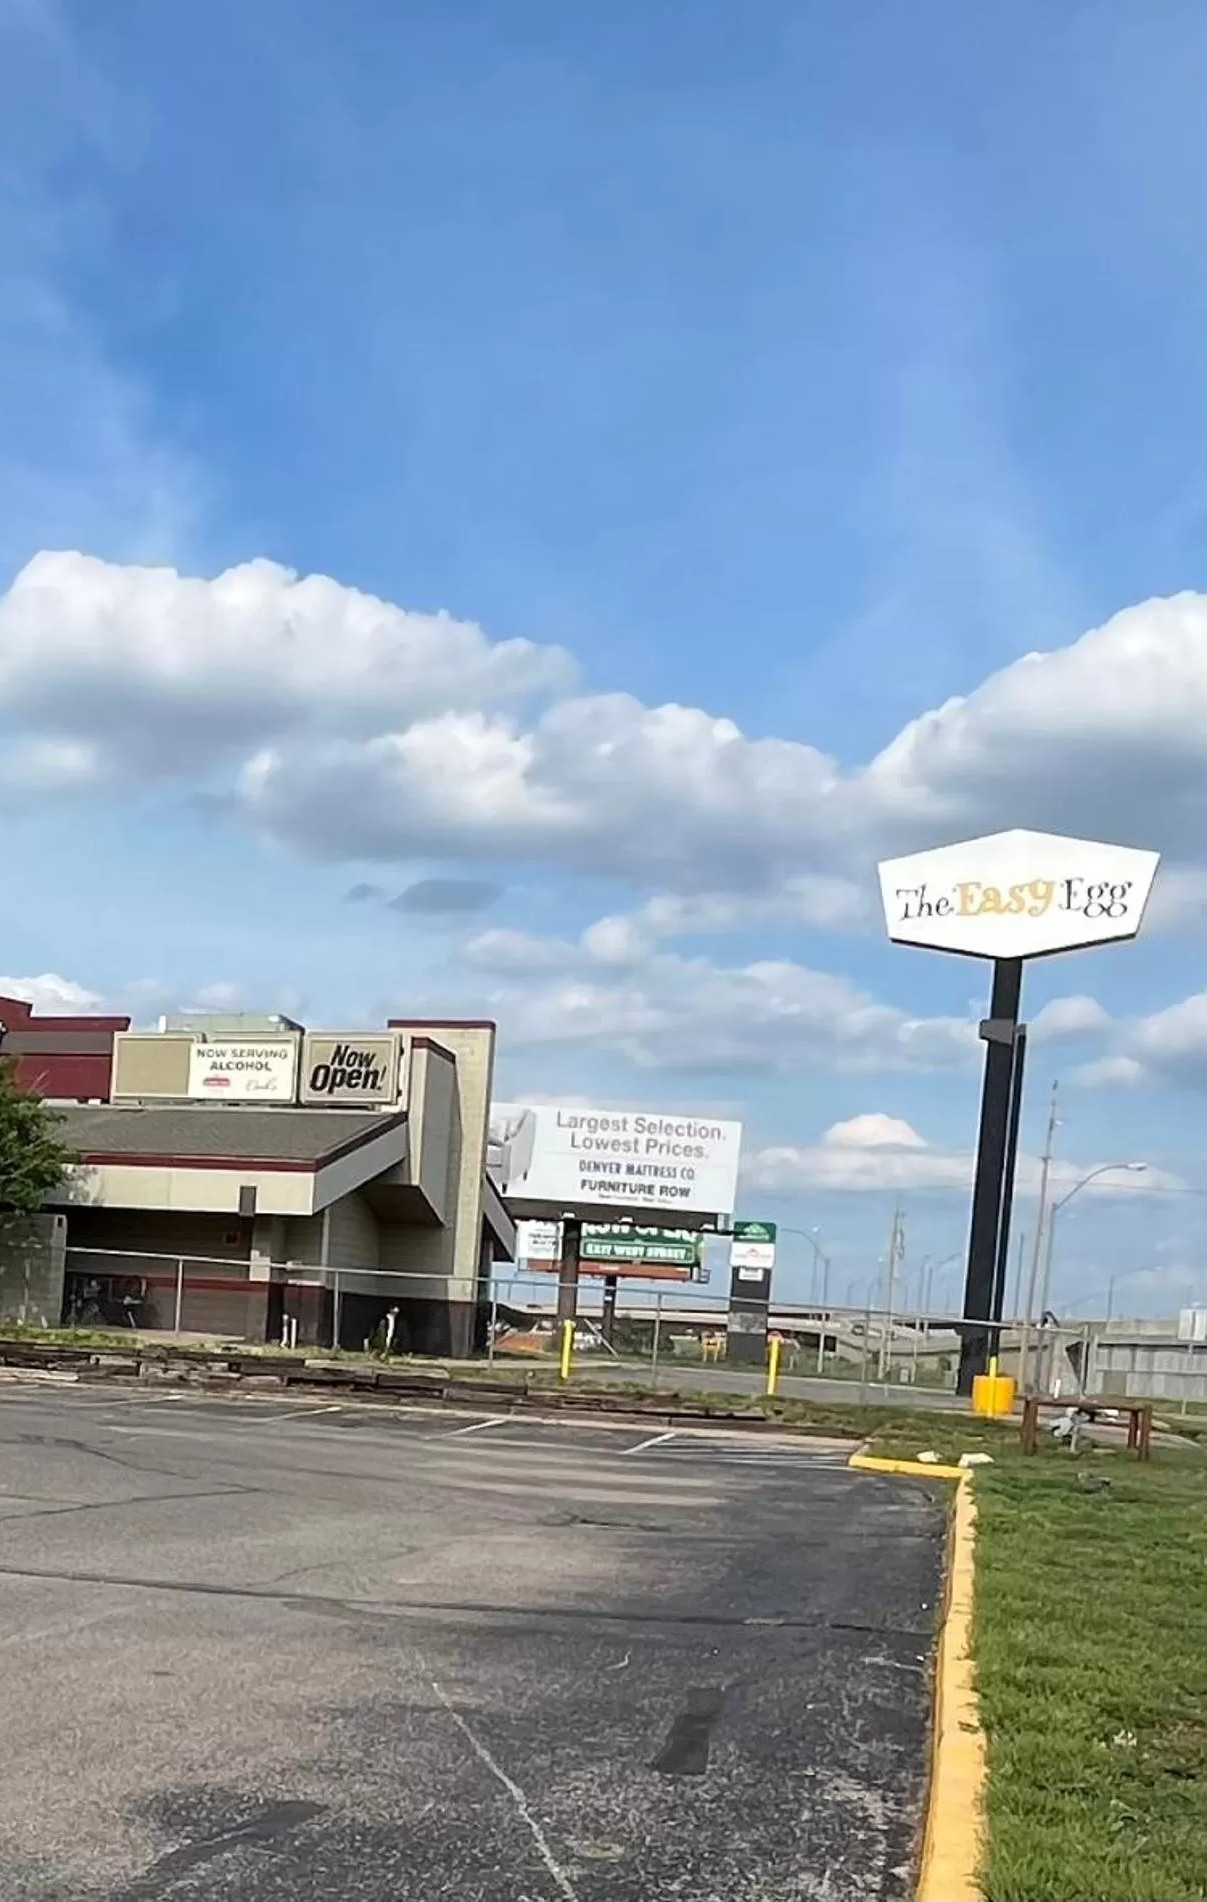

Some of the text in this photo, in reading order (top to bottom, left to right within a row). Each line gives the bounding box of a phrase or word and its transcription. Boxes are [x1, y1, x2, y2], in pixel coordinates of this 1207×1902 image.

[896, 878, 1133, 921] The Easy Egg
[197, 1048, 288, 1060] NOW SERVING
[330, 1045, 377, 1068] Now
[209, 1061, 272, 1072] ALCOHOL
[310, 1064, 387, 1094] Open!
[557, 1110, 727, 1142] Largest Selection.
[570, 1132, 710, 1160] Lowest Prices.
[579, 1159, 621, 1175] DENVER
[625, 1163, 677, 1179] MATTRESS
[580, 1178, 692, 1198] FURNITURE ROW
